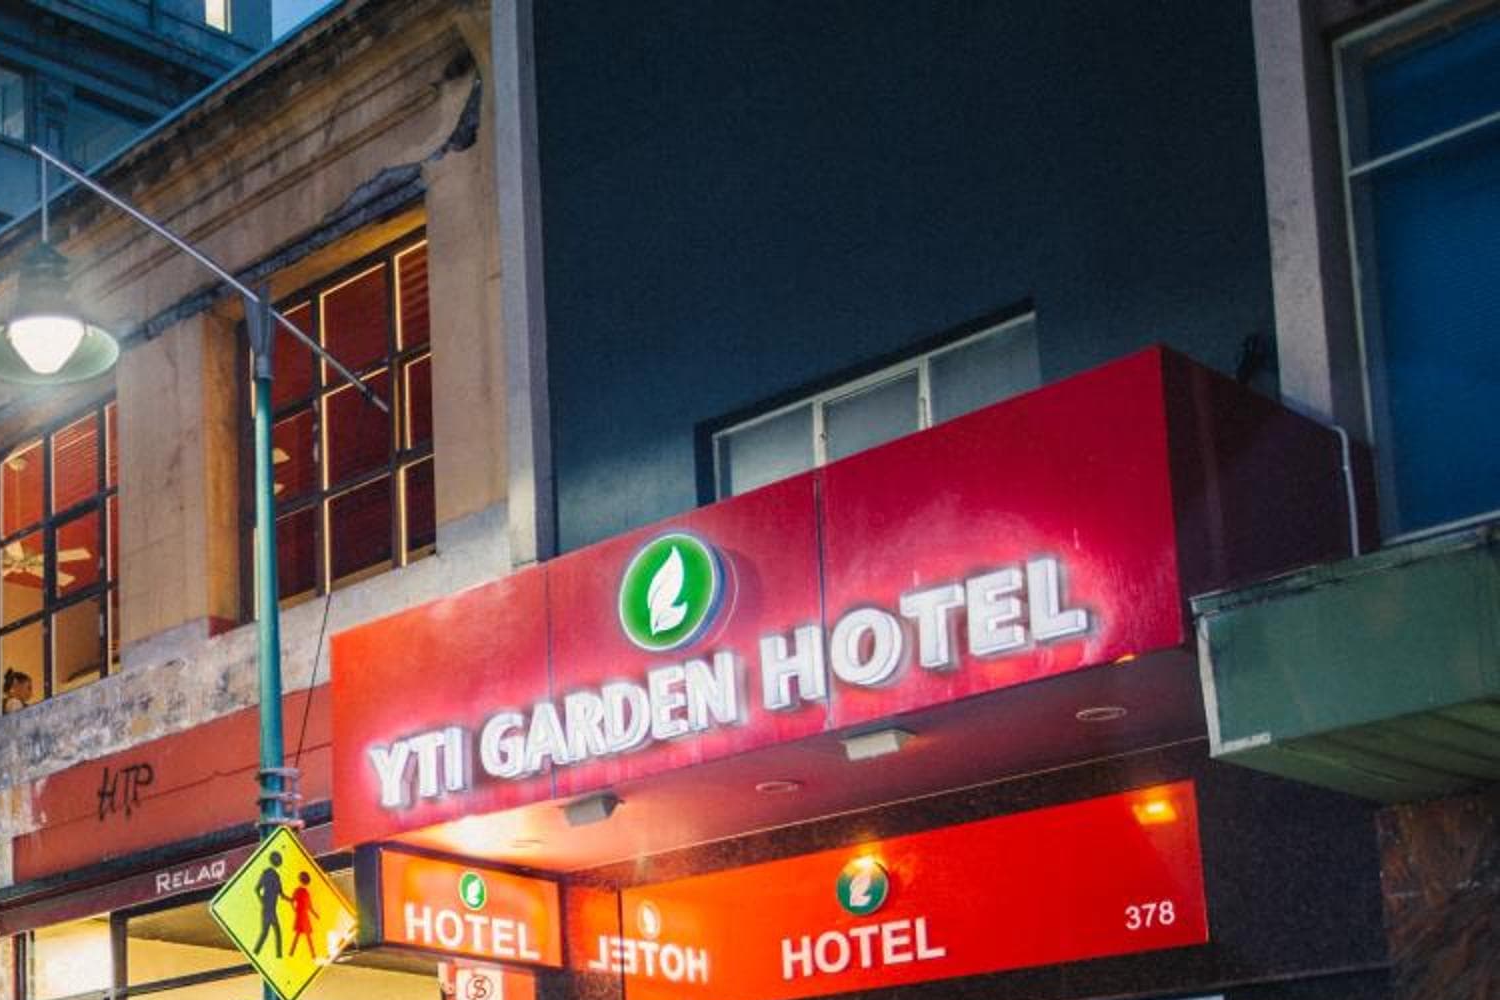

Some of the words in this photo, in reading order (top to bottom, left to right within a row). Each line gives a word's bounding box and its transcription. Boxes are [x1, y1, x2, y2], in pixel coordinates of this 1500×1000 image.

[370, 727, 468, 809] YTI
[479, 652, 740, 778] GARDEN
[758, 557, 1088, 711] HOTEL
[403, 903, 540, 959] HOTEL
[1124, 899, 1176, 931] 378
[780, 916, 947, 981] HOTEL
